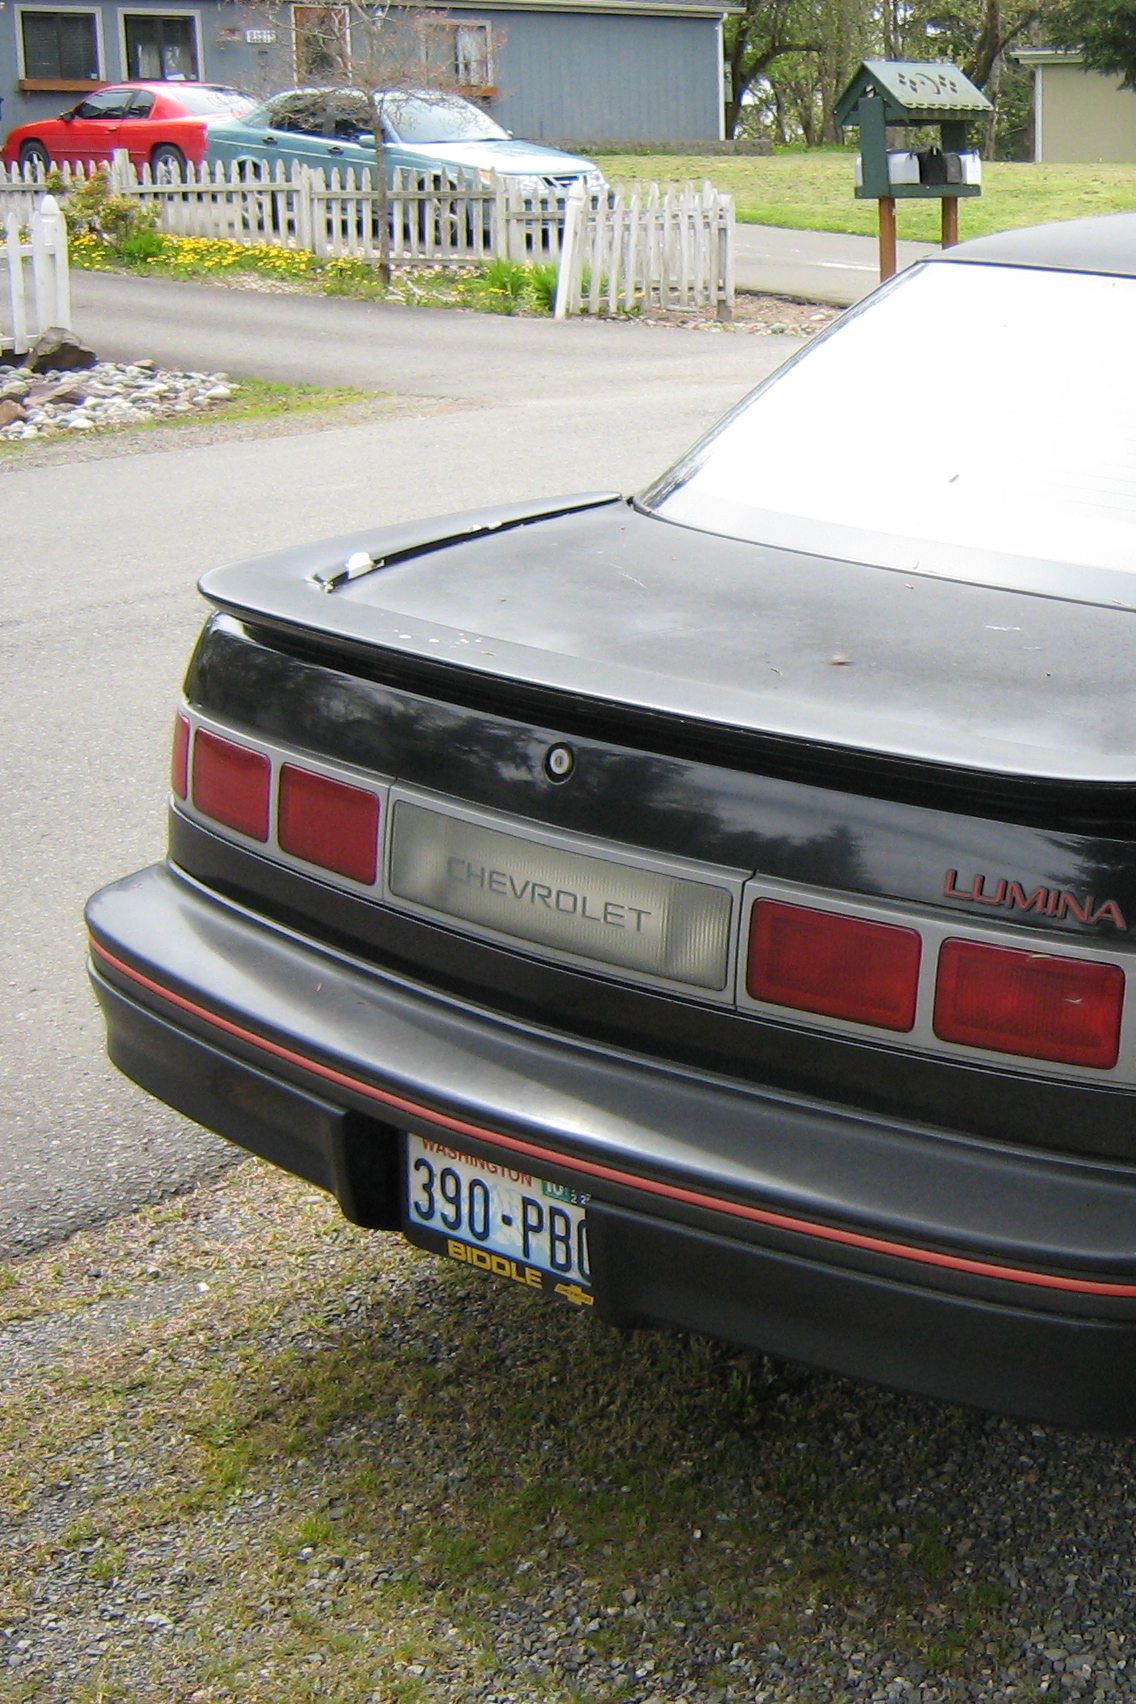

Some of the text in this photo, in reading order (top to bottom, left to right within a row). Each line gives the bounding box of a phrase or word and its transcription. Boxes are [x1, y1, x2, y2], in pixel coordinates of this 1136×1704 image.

[446, 856, 652, 934] CHEVROLET
[943, 868, 1128, 932] LUMINA
[447, 1239, 543, 1289] BIDDLE
